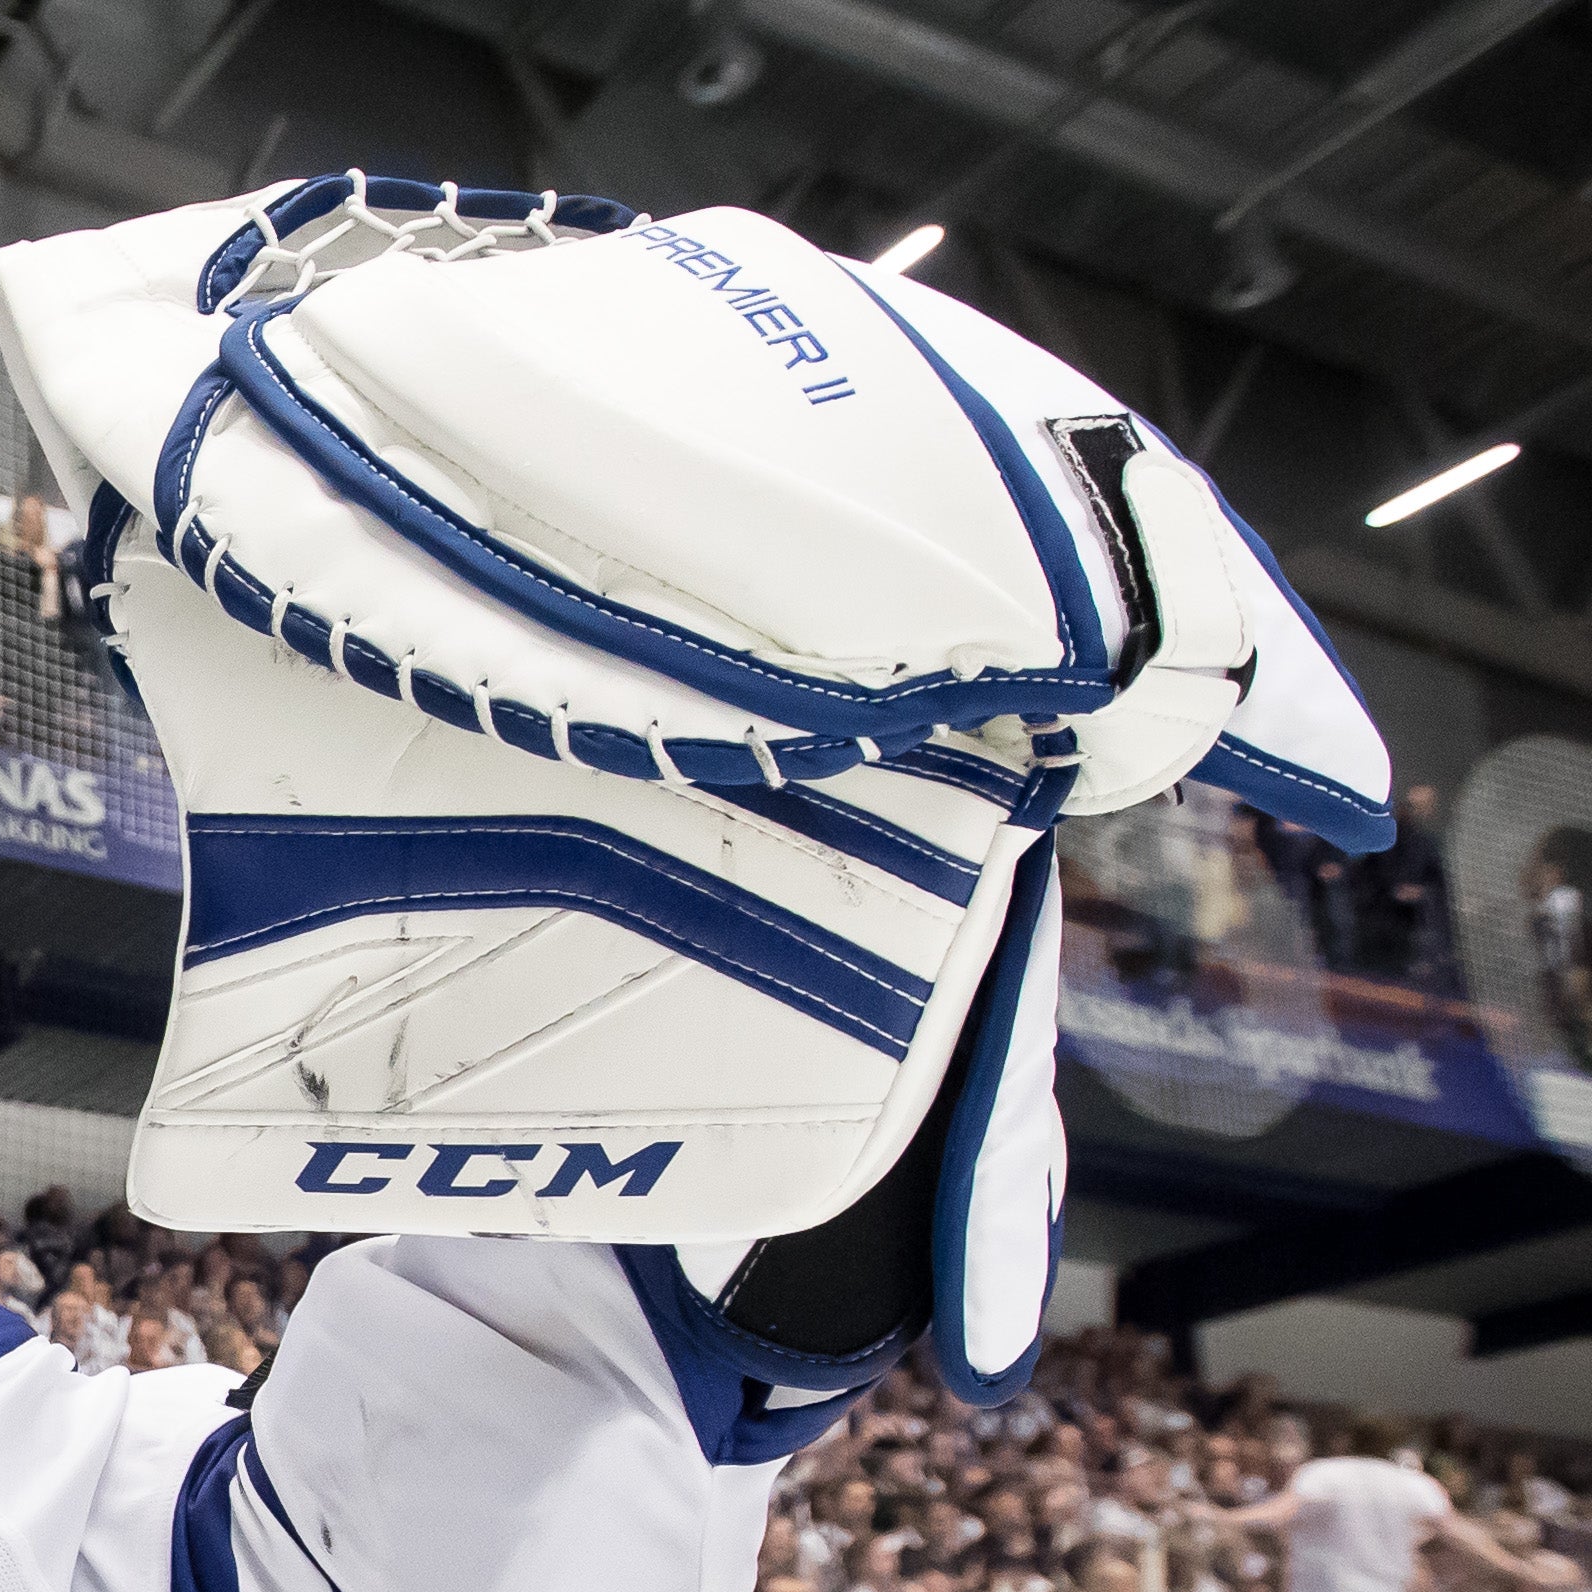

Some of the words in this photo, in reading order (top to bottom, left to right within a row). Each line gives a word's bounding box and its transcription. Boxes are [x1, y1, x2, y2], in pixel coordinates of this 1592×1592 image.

[620, 225, 829, 370] PREMIER
[802, 376, 856, 406] II
[293, 1140, 686, 1198] CCM
